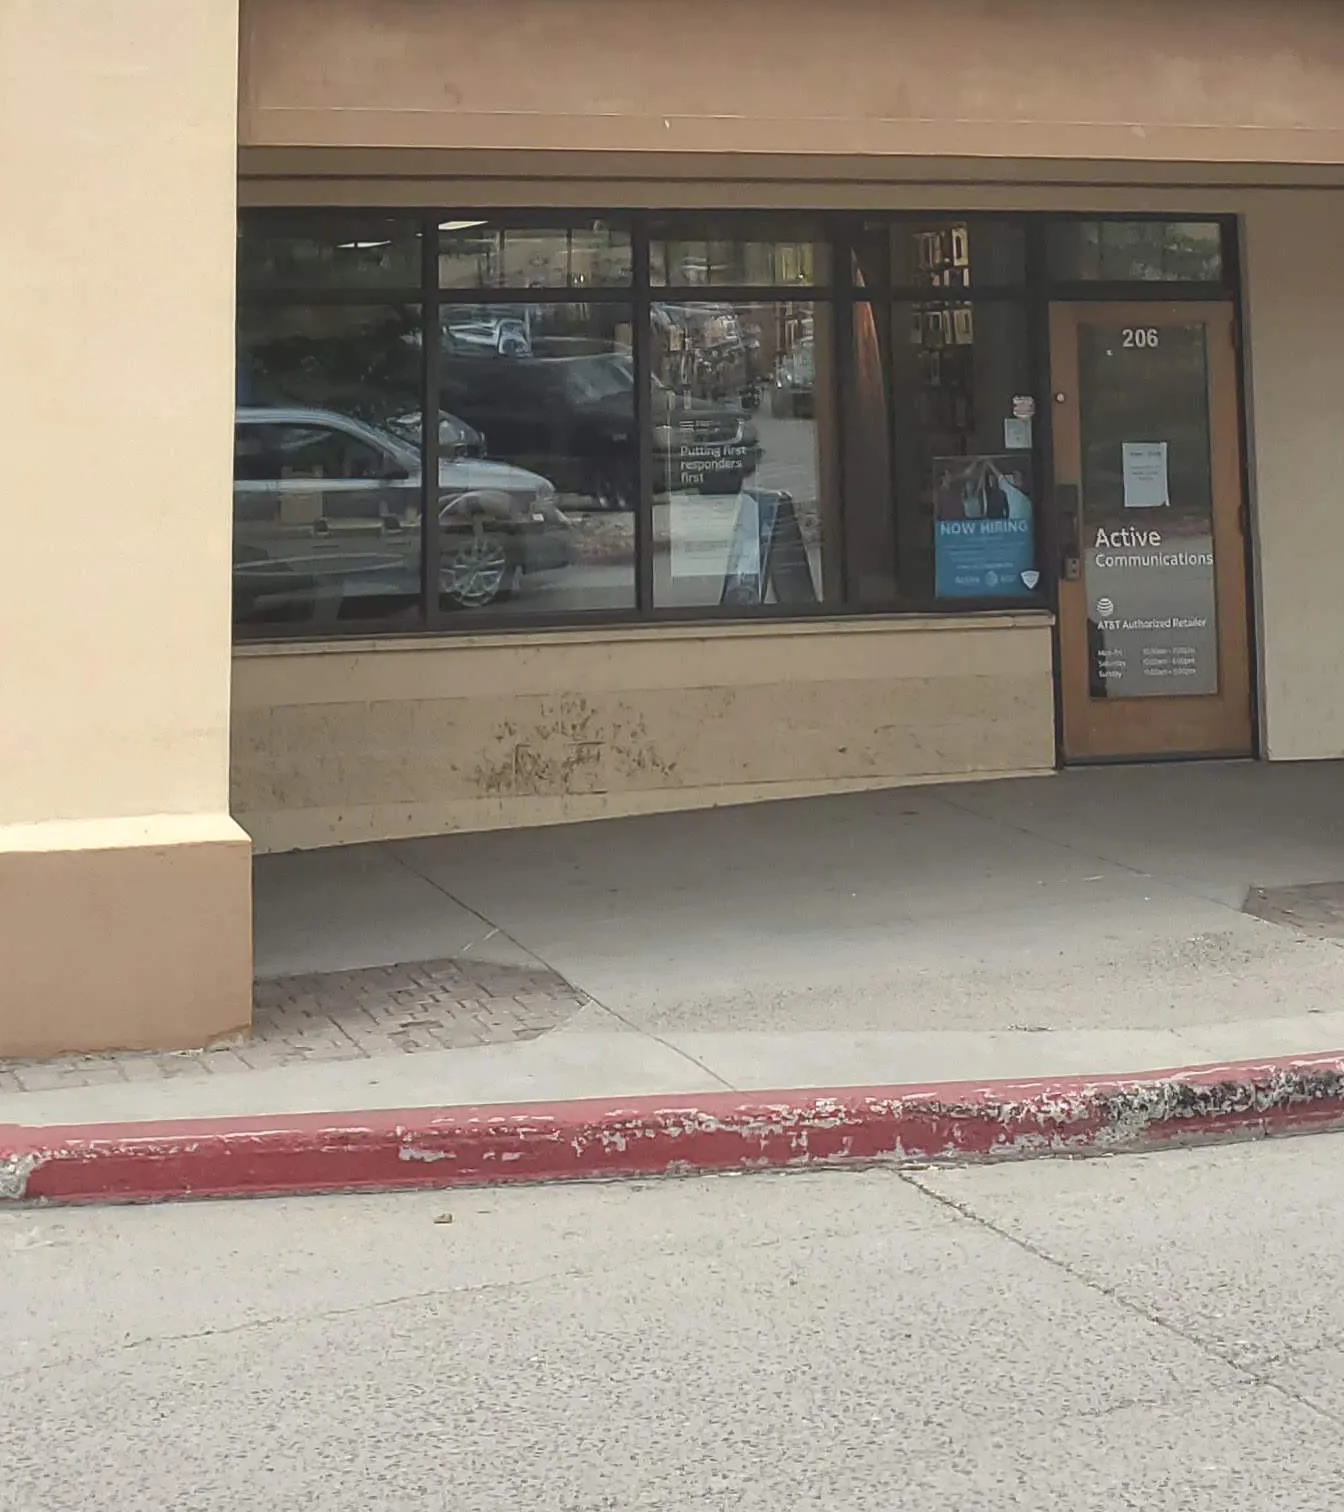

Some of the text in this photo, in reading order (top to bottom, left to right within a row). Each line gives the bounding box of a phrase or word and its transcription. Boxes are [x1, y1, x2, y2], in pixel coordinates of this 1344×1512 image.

[1122, 328, 1159, 348] 206
[680, 445, 746, 458] Putting first
[680, 458, 742, 471] responders
[680, 472, 704, 484] first
[940, 519, 1029, 536] NOW HIRING
[1095, 526, 1161, 548] Active
[1095, 552, 1213, 568] Communications
[1097, 619, 1121, 631] AT&T
[1122, 618, 1172, 630] Authorized
